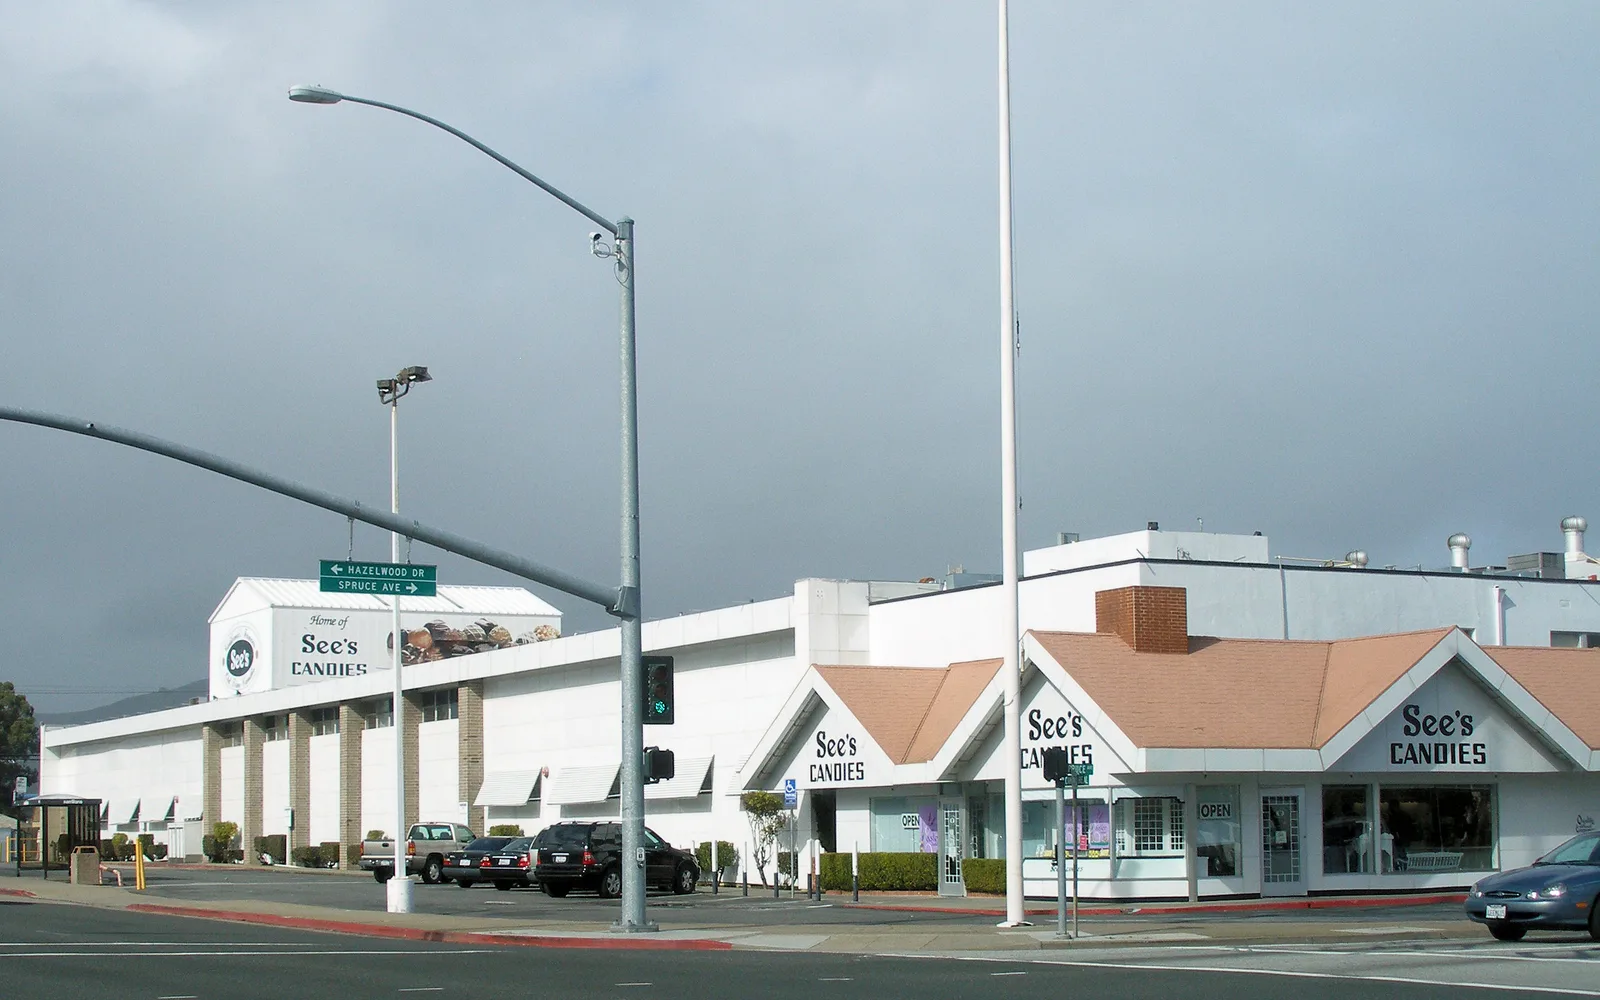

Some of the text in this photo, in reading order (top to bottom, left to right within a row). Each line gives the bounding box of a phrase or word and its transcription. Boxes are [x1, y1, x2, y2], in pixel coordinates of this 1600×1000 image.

[348, 566, 425, 577] HAZELWOOD DR
[338, 580, 401, 592] SPRUCE AVE
[309, 614, 350, 631] Home of
[301, 633, 358, 655] See's
[230, 649, 250, 671] See's
[291, 661, 367, 677] CANDIES
[1028, 708, 1082, 741] See's
[1402, 704, 1474, 737] See's
[816, 730, 857, 759] See's
[1390, 742, 1486, 765] CANDIES
[1020, 743, 1093, 770] CAIES
[809, 761, 865, 783] CANDIES
[902, 814, 920, 827] OPEN
[1201, 803, 1231, 818] OPEN
